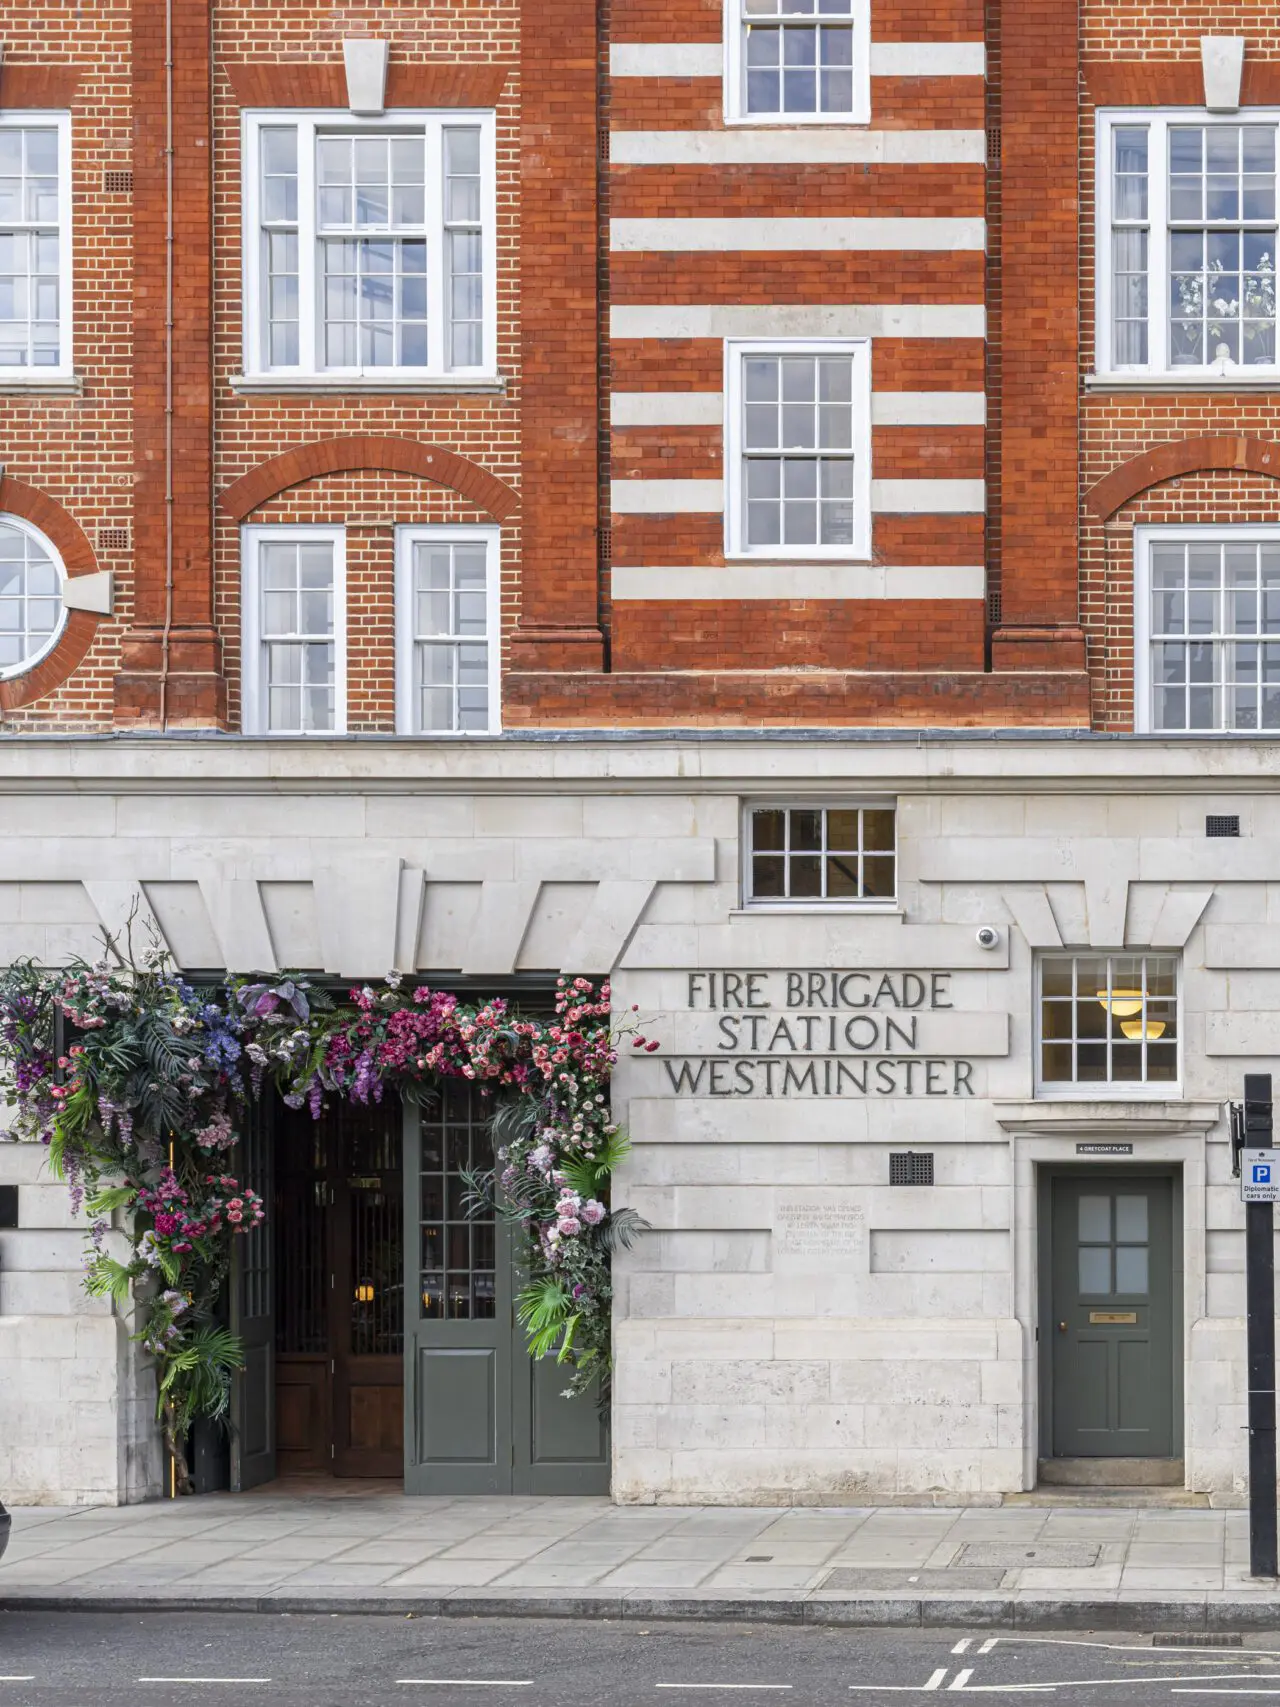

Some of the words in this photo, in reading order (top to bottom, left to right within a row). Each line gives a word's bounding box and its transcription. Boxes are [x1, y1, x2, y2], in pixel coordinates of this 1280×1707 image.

[687, 972, 771, 1008] FIRE
[785, 972, 954, 1009] BRIGADE
[717, 1015, 918, 1051] STATION
[663, 1060, 976, 1096] WESTMINSTER
[1256, 1167, 1268, 1182] P
[1262, 1192, 1277, 1200] only
